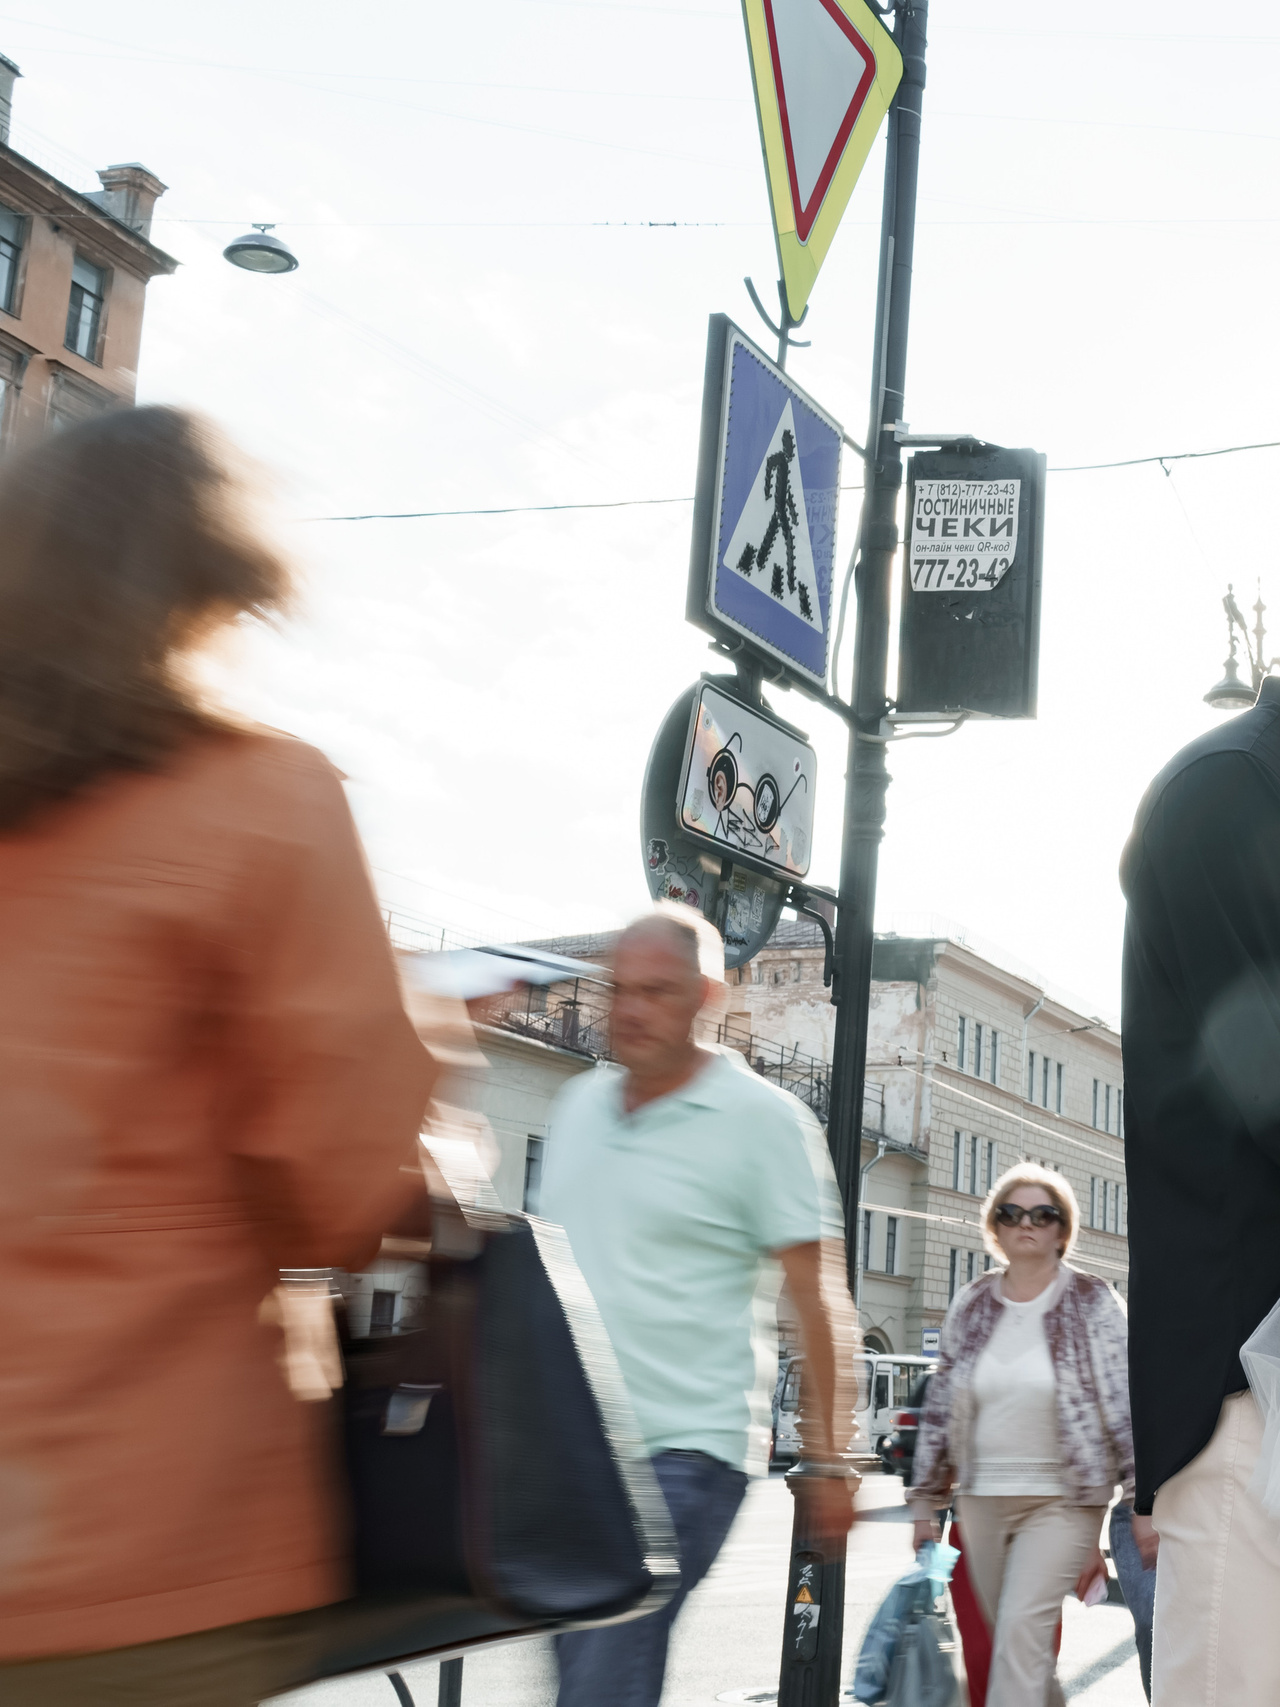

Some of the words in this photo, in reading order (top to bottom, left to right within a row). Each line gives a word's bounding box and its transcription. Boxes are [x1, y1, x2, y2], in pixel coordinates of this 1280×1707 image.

[928, 484, 934, 495] 7
[937, 483, 1015, 498] (812)-777-23-43
[917, 498, 1014, 515] ГОСТИНИЧНЫЕ
[916, 517, 1014, 537] ЧЕКИ
[916, 542, 952, 552] он-лайн
[955, 544, 974, 552] чеки
[977, 541, 1010, 552] QR-код
